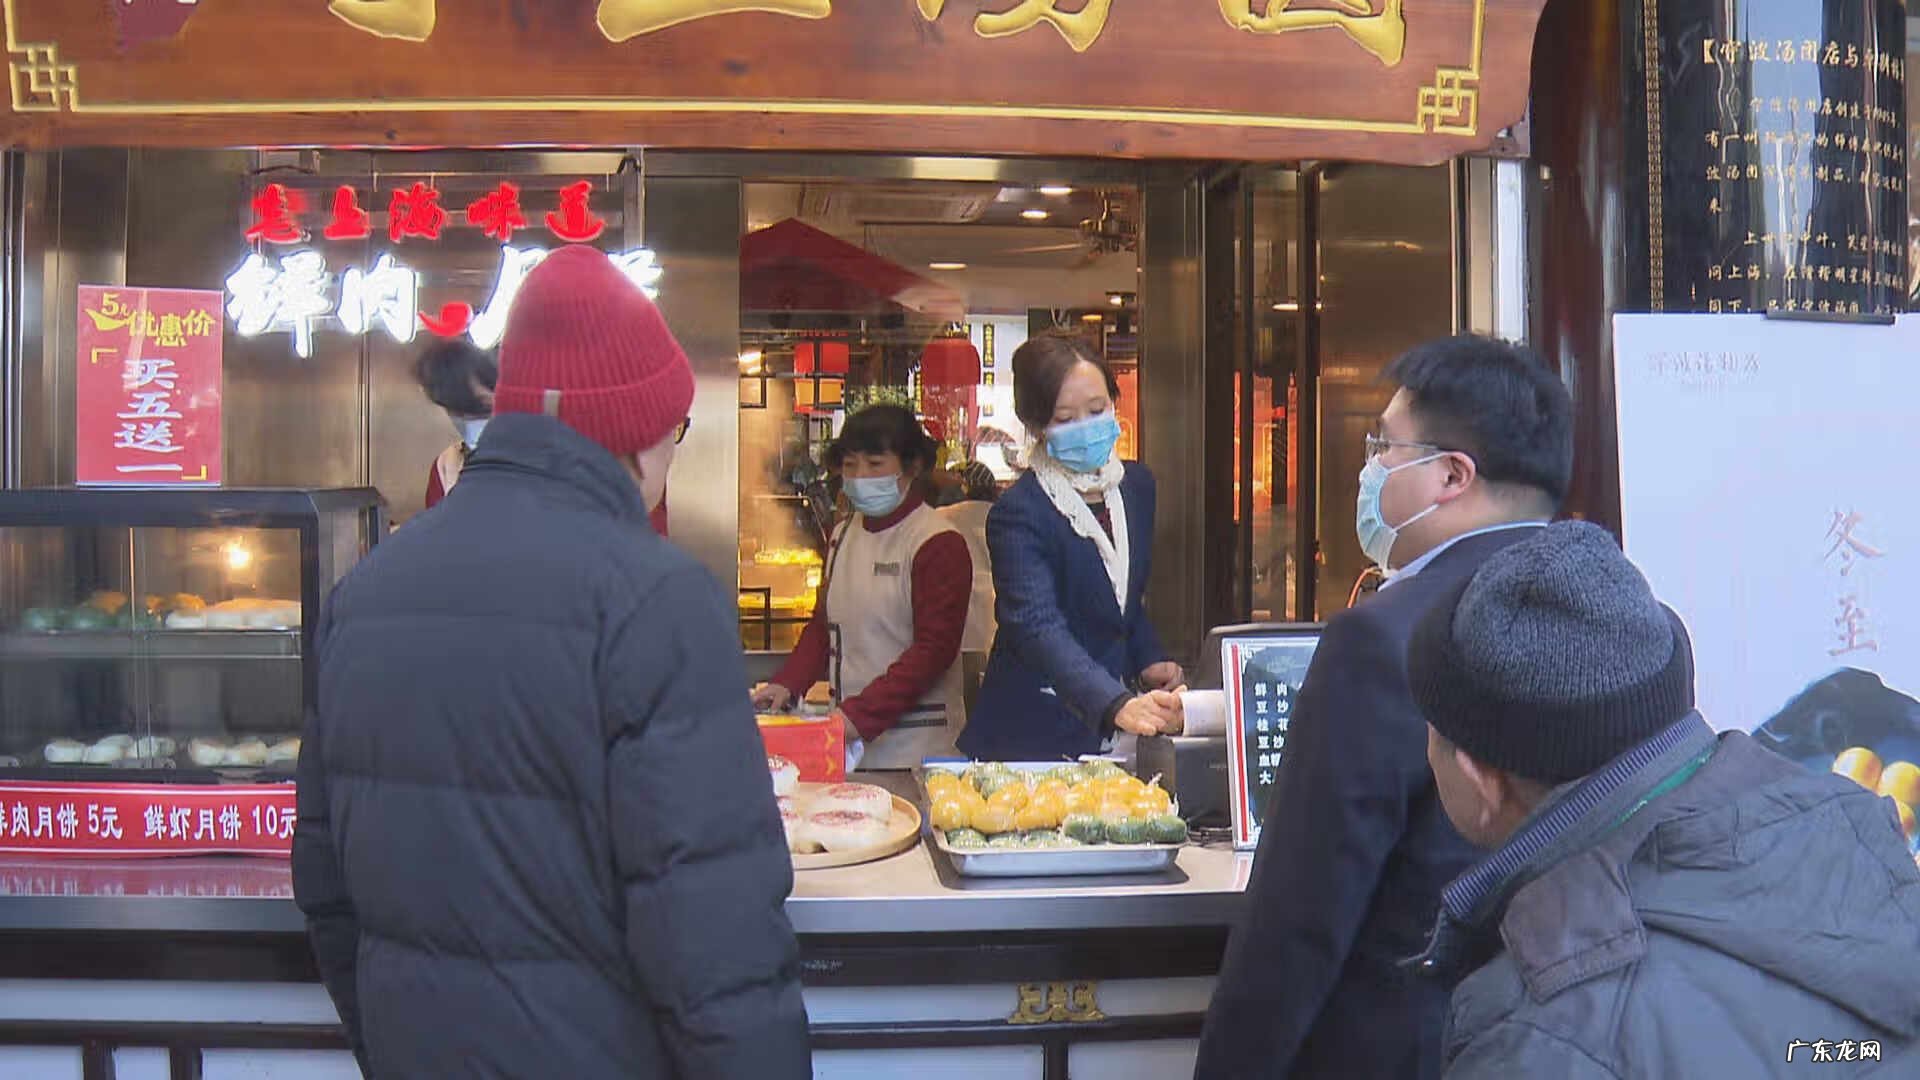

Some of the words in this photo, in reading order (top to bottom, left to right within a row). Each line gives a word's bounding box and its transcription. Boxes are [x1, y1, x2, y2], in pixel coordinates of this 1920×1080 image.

[246, 182, 604, 242] 老上海味道
[227, 247, 660, 357] 鲜肉
[128, 308, 216, 347] 优惠价
[114, 358, 185, 472] 买五送一
[1256, 700, 1289, 714] 豆沙
[88, 803, 123, 840] 5元
[144, 804, 242, 841] 鲜虾月饼
[251, 804, 297, 840] 10元
